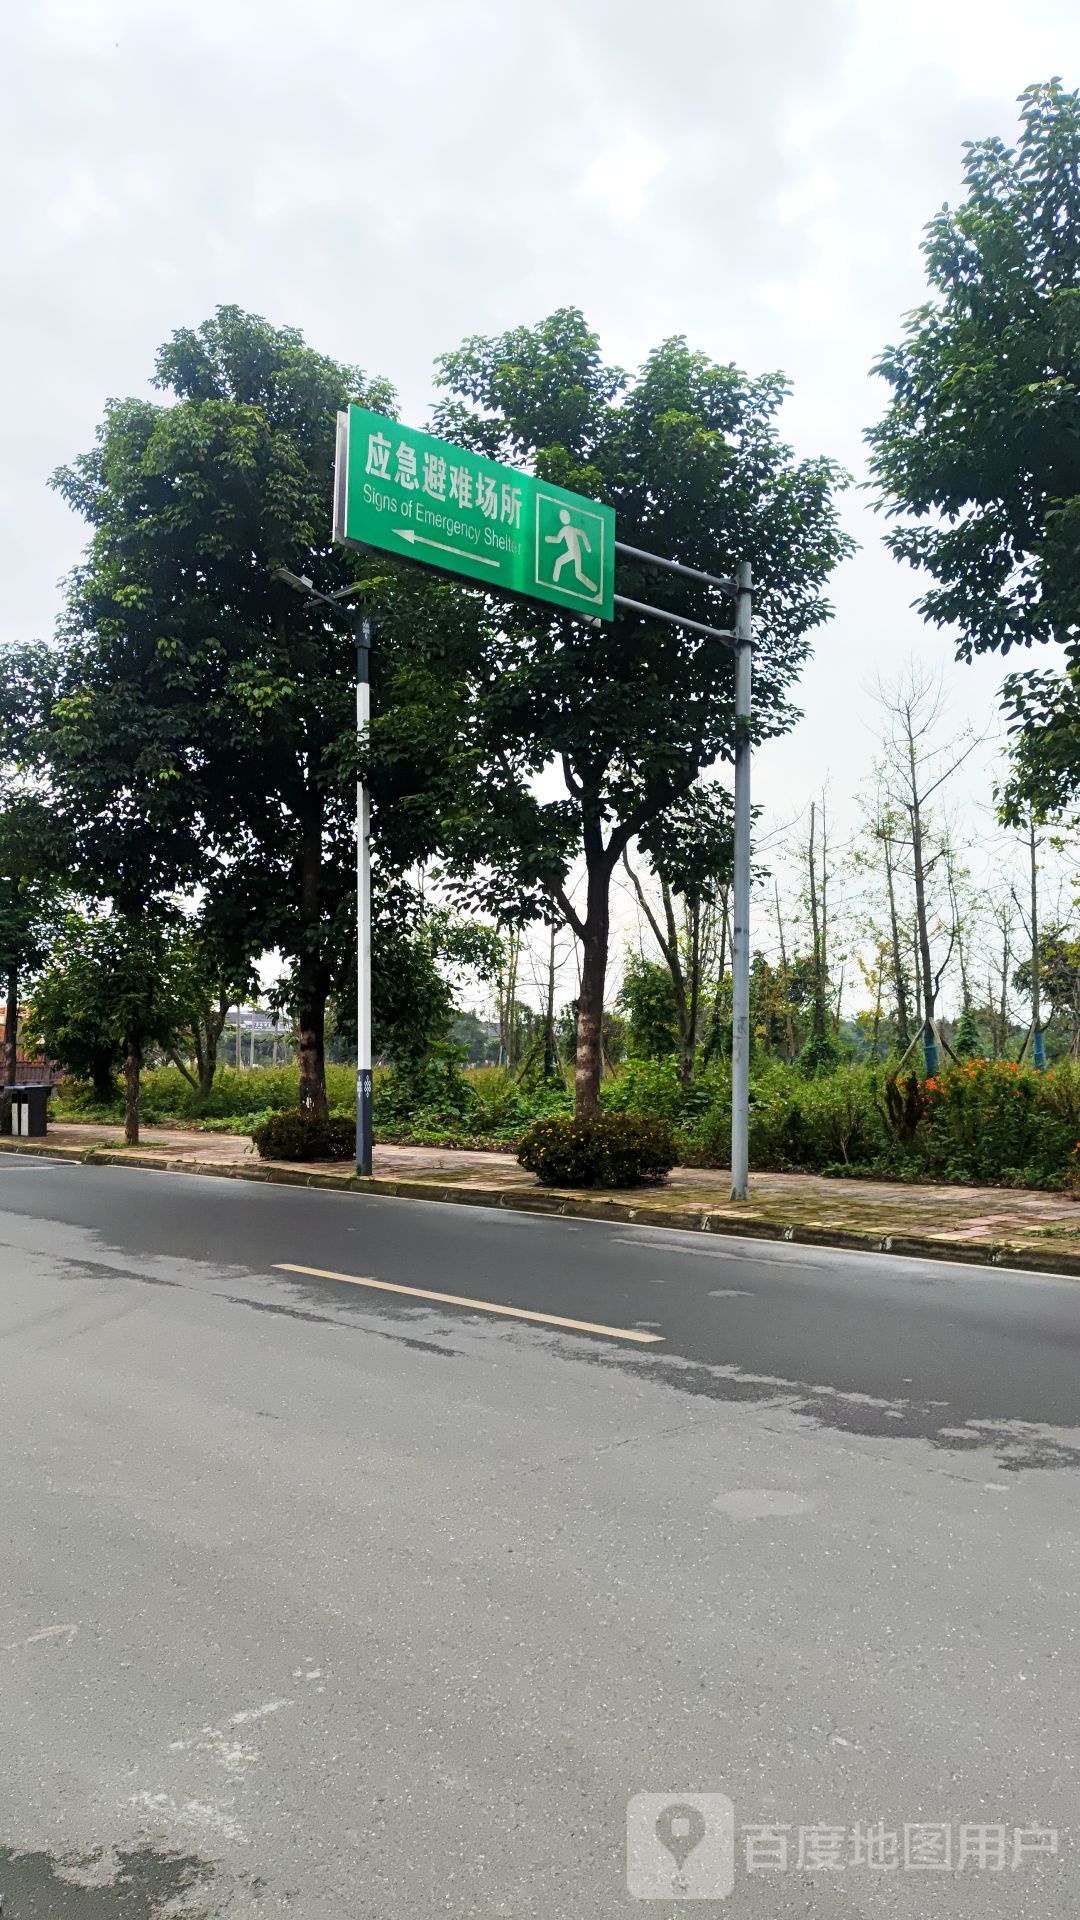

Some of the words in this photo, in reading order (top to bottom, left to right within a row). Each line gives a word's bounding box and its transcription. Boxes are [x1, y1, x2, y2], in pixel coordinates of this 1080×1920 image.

[363, 483, 398, 512] Signs
[400, 500, 413, 518] of
[416, 503, 481, 541] Emergency
[484, 527, 522, 556] Shelter
[365, 432, 522, 528] 应急避难场所
